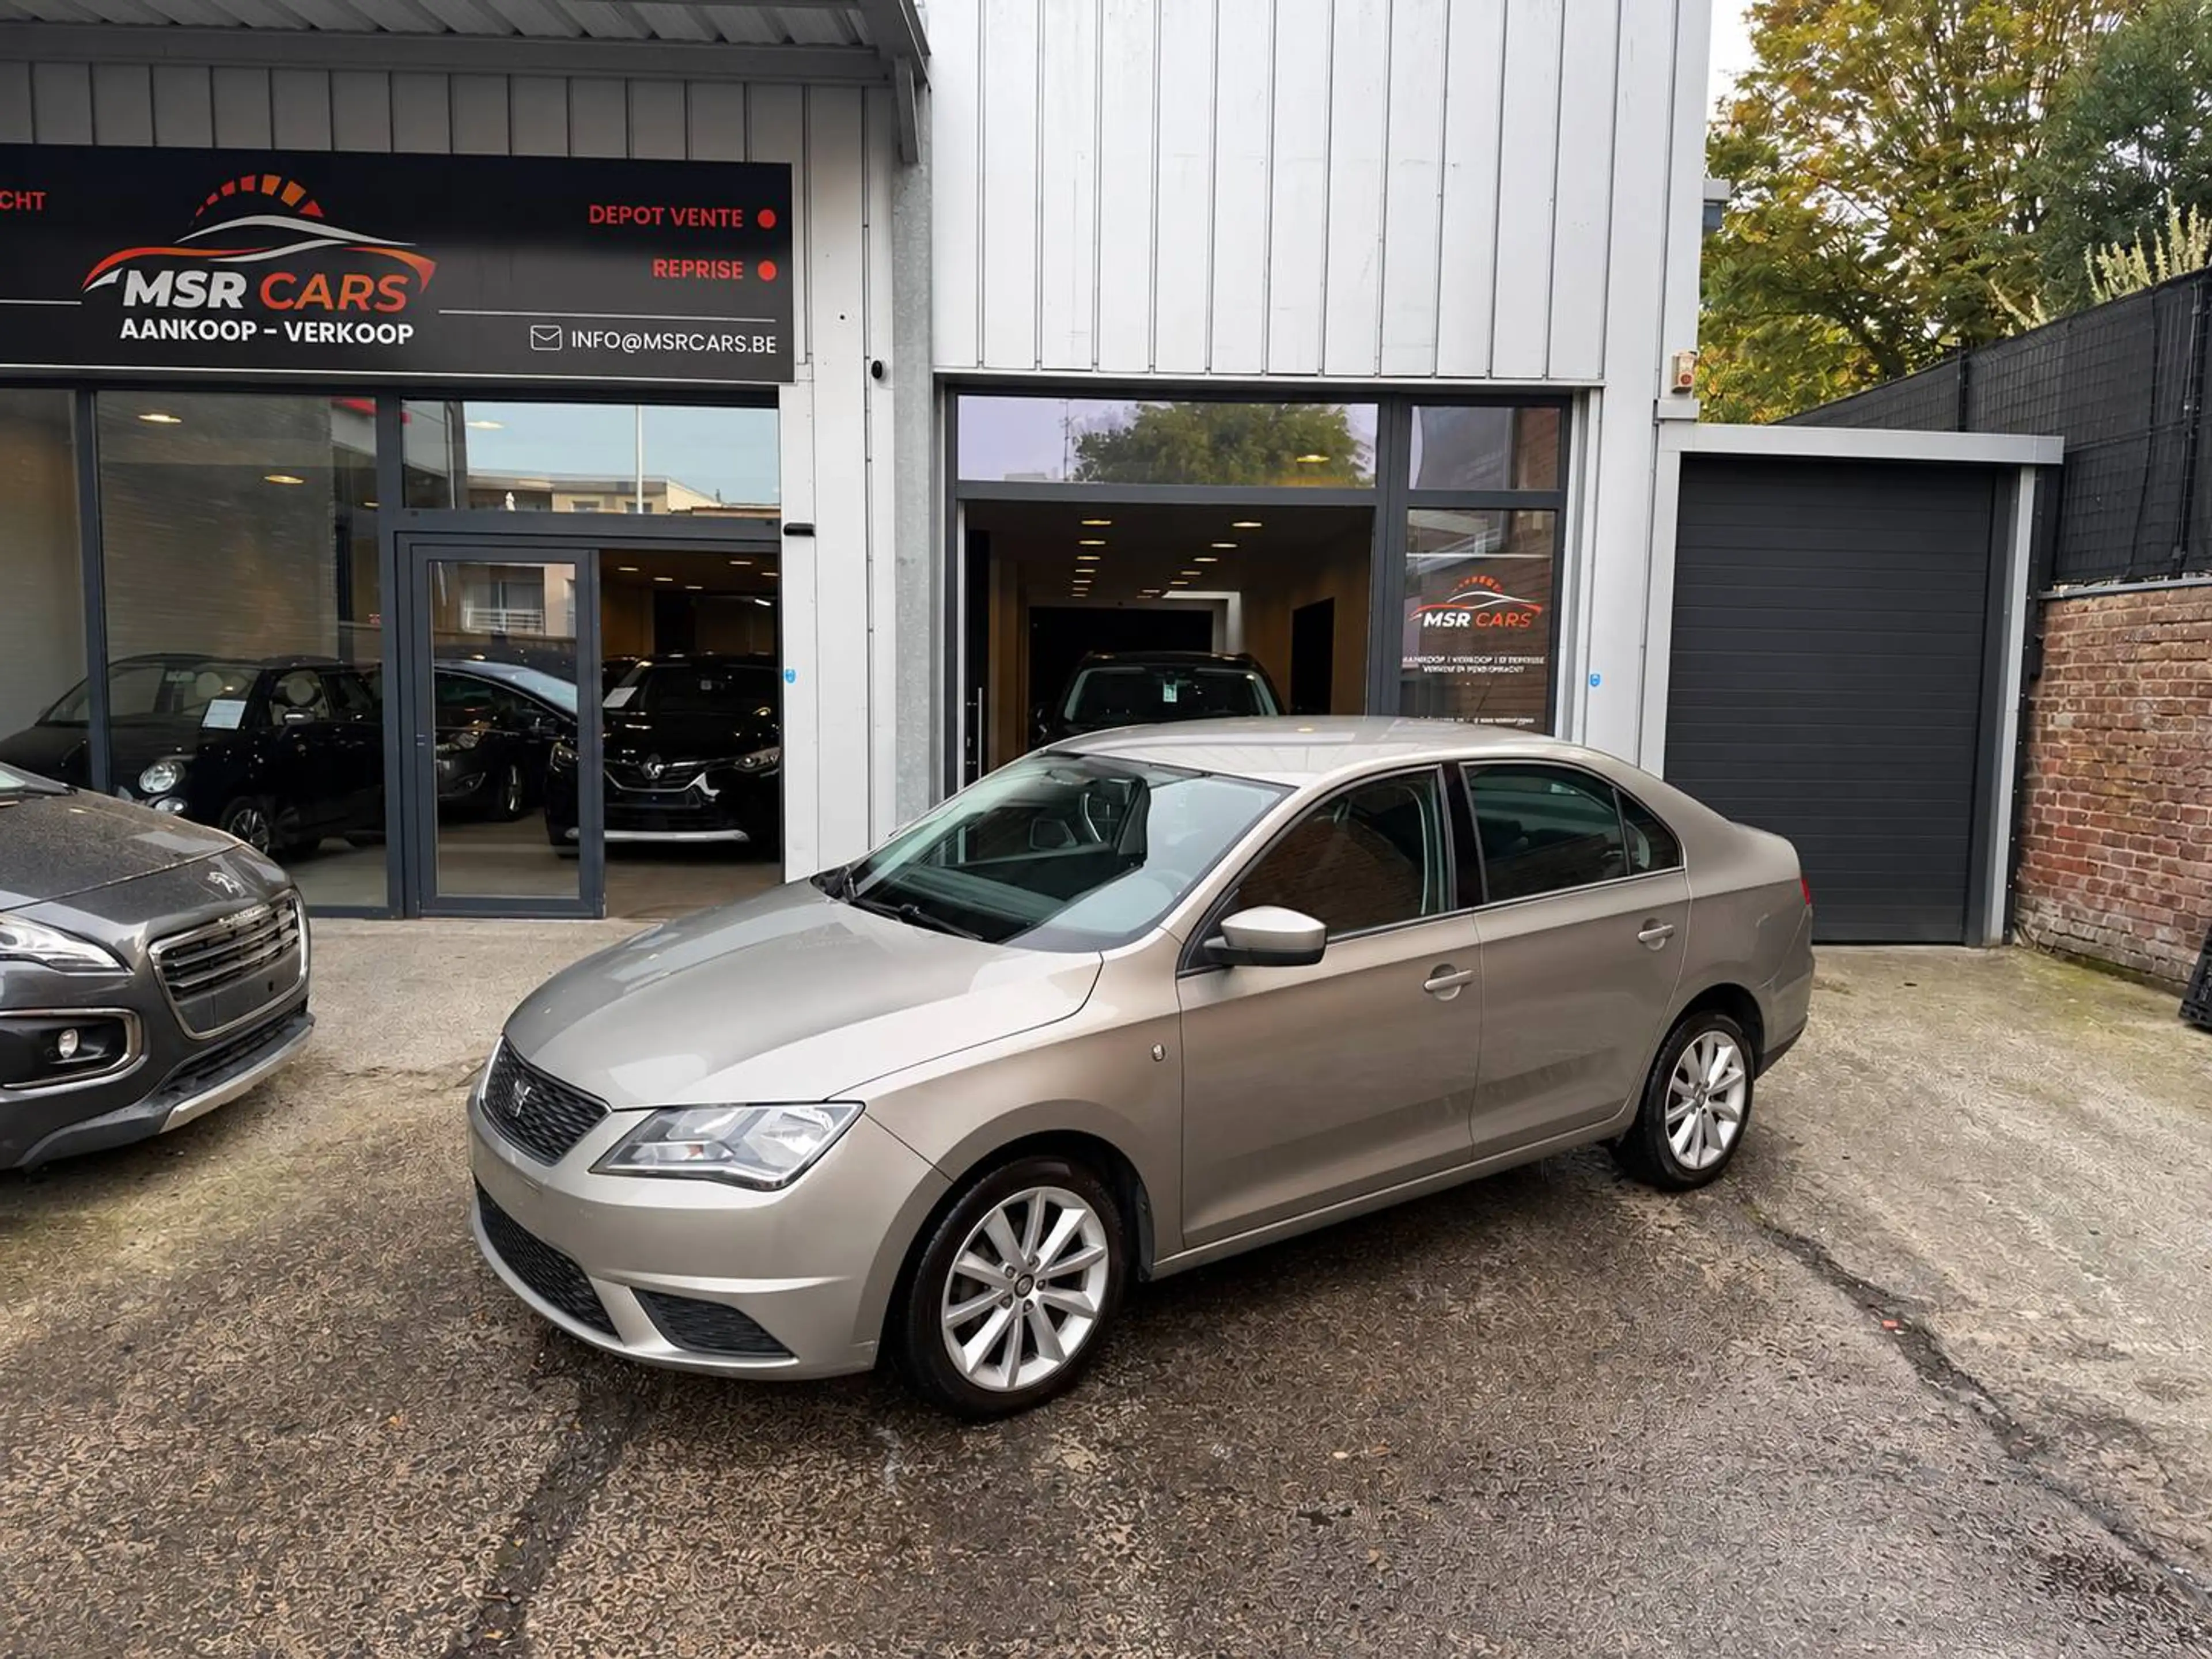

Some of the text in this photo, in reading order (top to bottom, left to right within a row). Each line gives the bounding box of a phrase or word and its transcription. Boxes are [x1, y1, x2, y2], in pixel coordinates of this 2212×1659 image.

[589, 204, 744, 228] DEPOT VENTE
[653, 259, 744, 279] REPRISE
[123, 270, 409, 312] MSR CARS
[120, 318, 257, 341] AANKOOP
[283, 321, 414, 344] VERKOOP
[571, 330, 777, 354] INFO@MSRCARS.BE
[1423, 611, 1532, 628] MSR CARS
